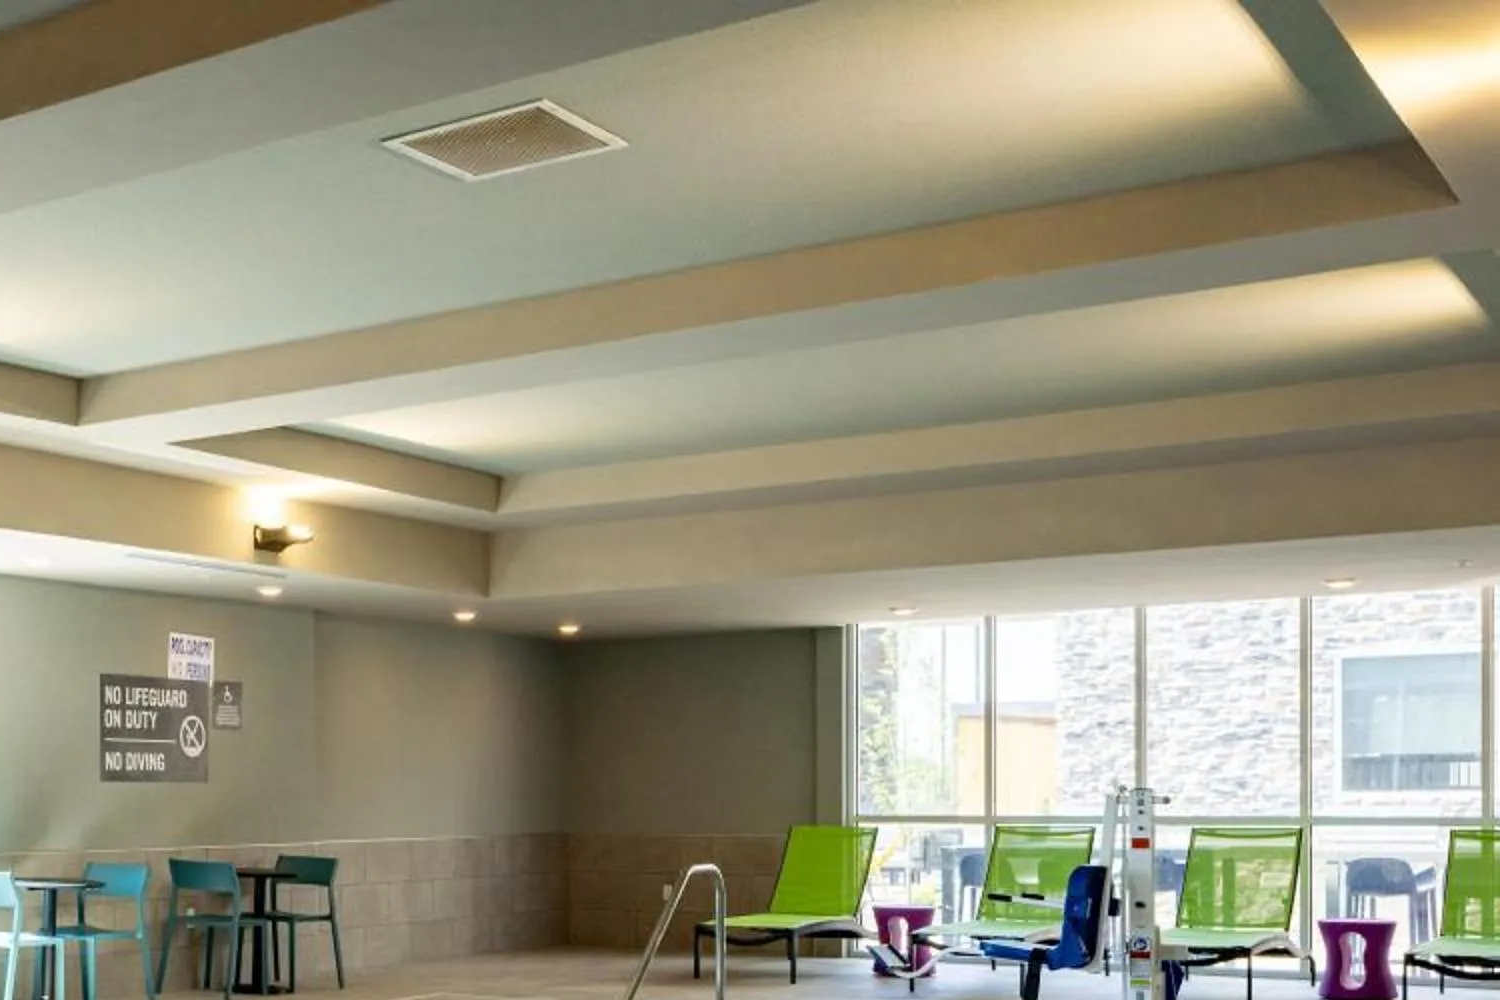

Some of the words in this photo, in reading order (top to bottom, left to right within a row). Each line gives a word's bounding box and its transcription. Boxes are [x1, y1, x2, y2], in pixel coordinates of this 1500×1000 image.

[105, 685, 121, 705] NO
[125, 687, 187, 708] LIFEGUARD
[104, 709, 121, 729] ON
[125, 711, 158, 730] DUTY
[105, 752, 122, 771] NO
[125, 753, 165, 771] DIVING
